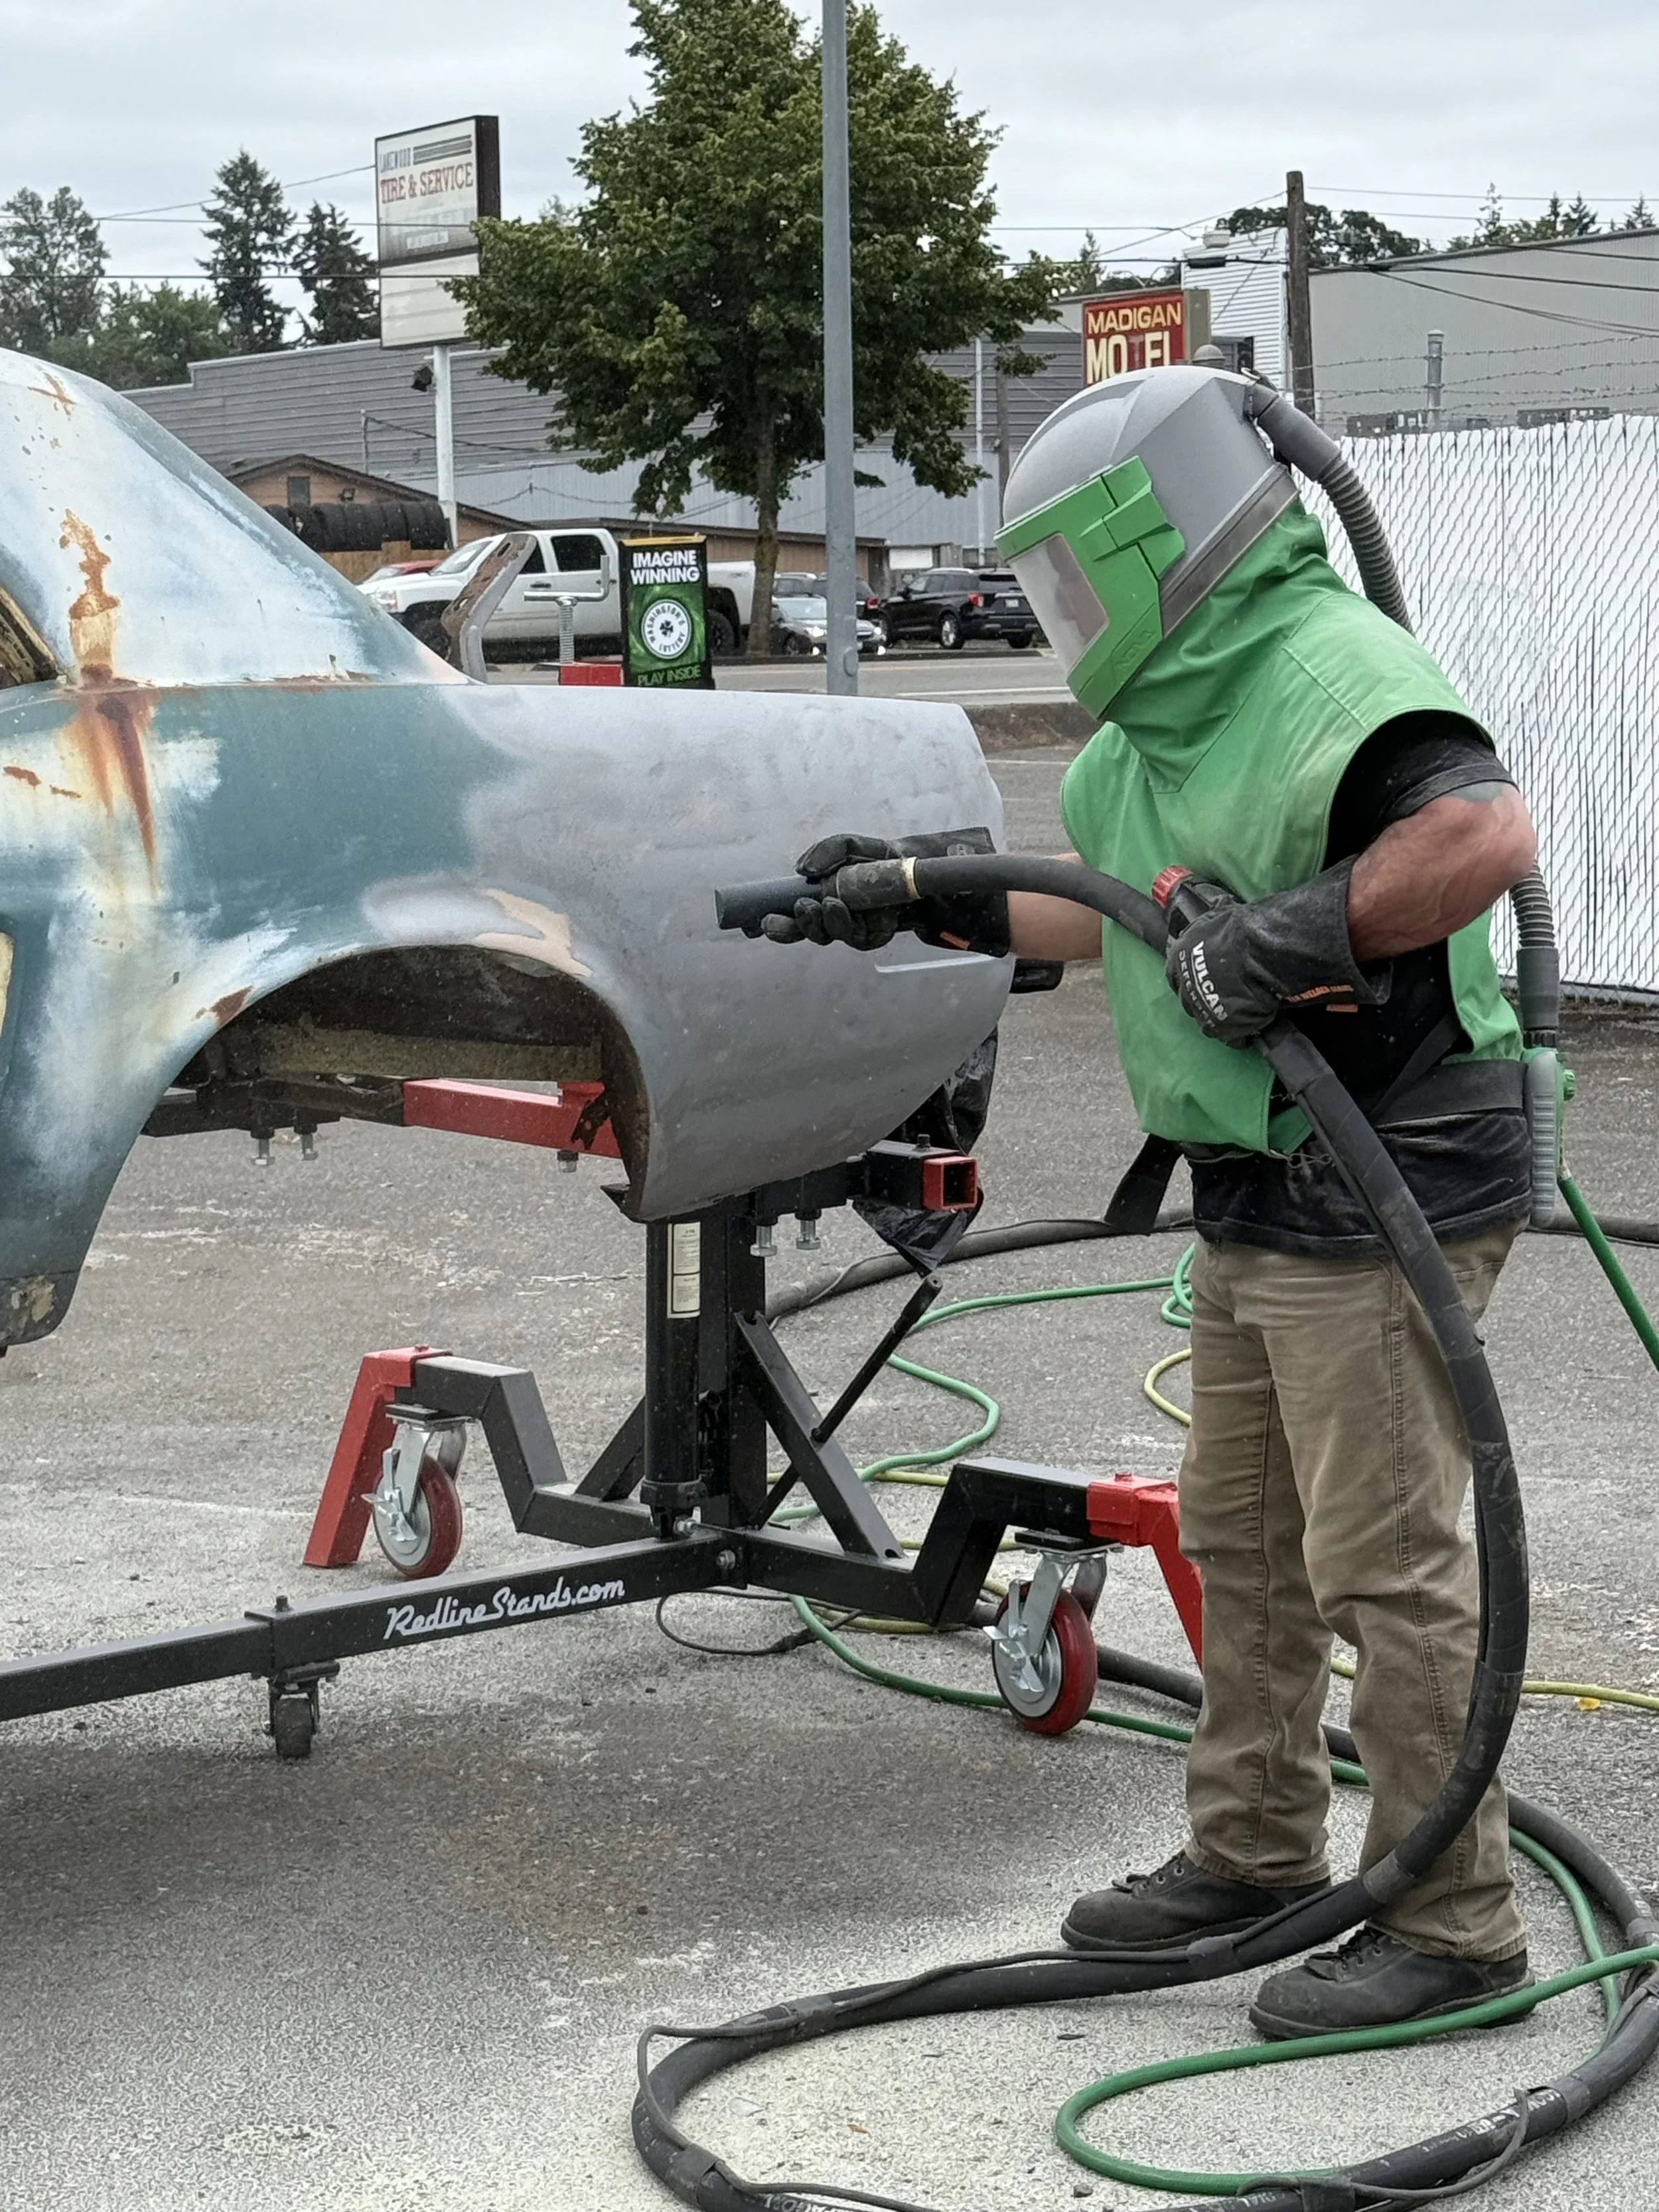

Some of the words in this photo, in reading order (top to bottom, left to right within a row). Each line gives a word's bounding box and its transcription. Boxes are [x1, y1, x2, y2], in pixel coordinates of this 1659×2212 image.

[380, 176, 406, 204] TIRE
[408, 174, 418, 198] &
[420, 162, 473, 196] SERVICE
[1087, 303, 1182, 334] MADIGAN
[632, 550, 697, 568] IMAGINE
[630, 566, 700, 585] WINNING
[659, 631, 685, 652] LOTTERY
[638, 672, 664, 686] PLAY
[667, 666, 701, 684] INSIDE
[1192, 940, 1228, 1021] VULCAN
[383, 1576, 625, 1639] RedlineStands.com
